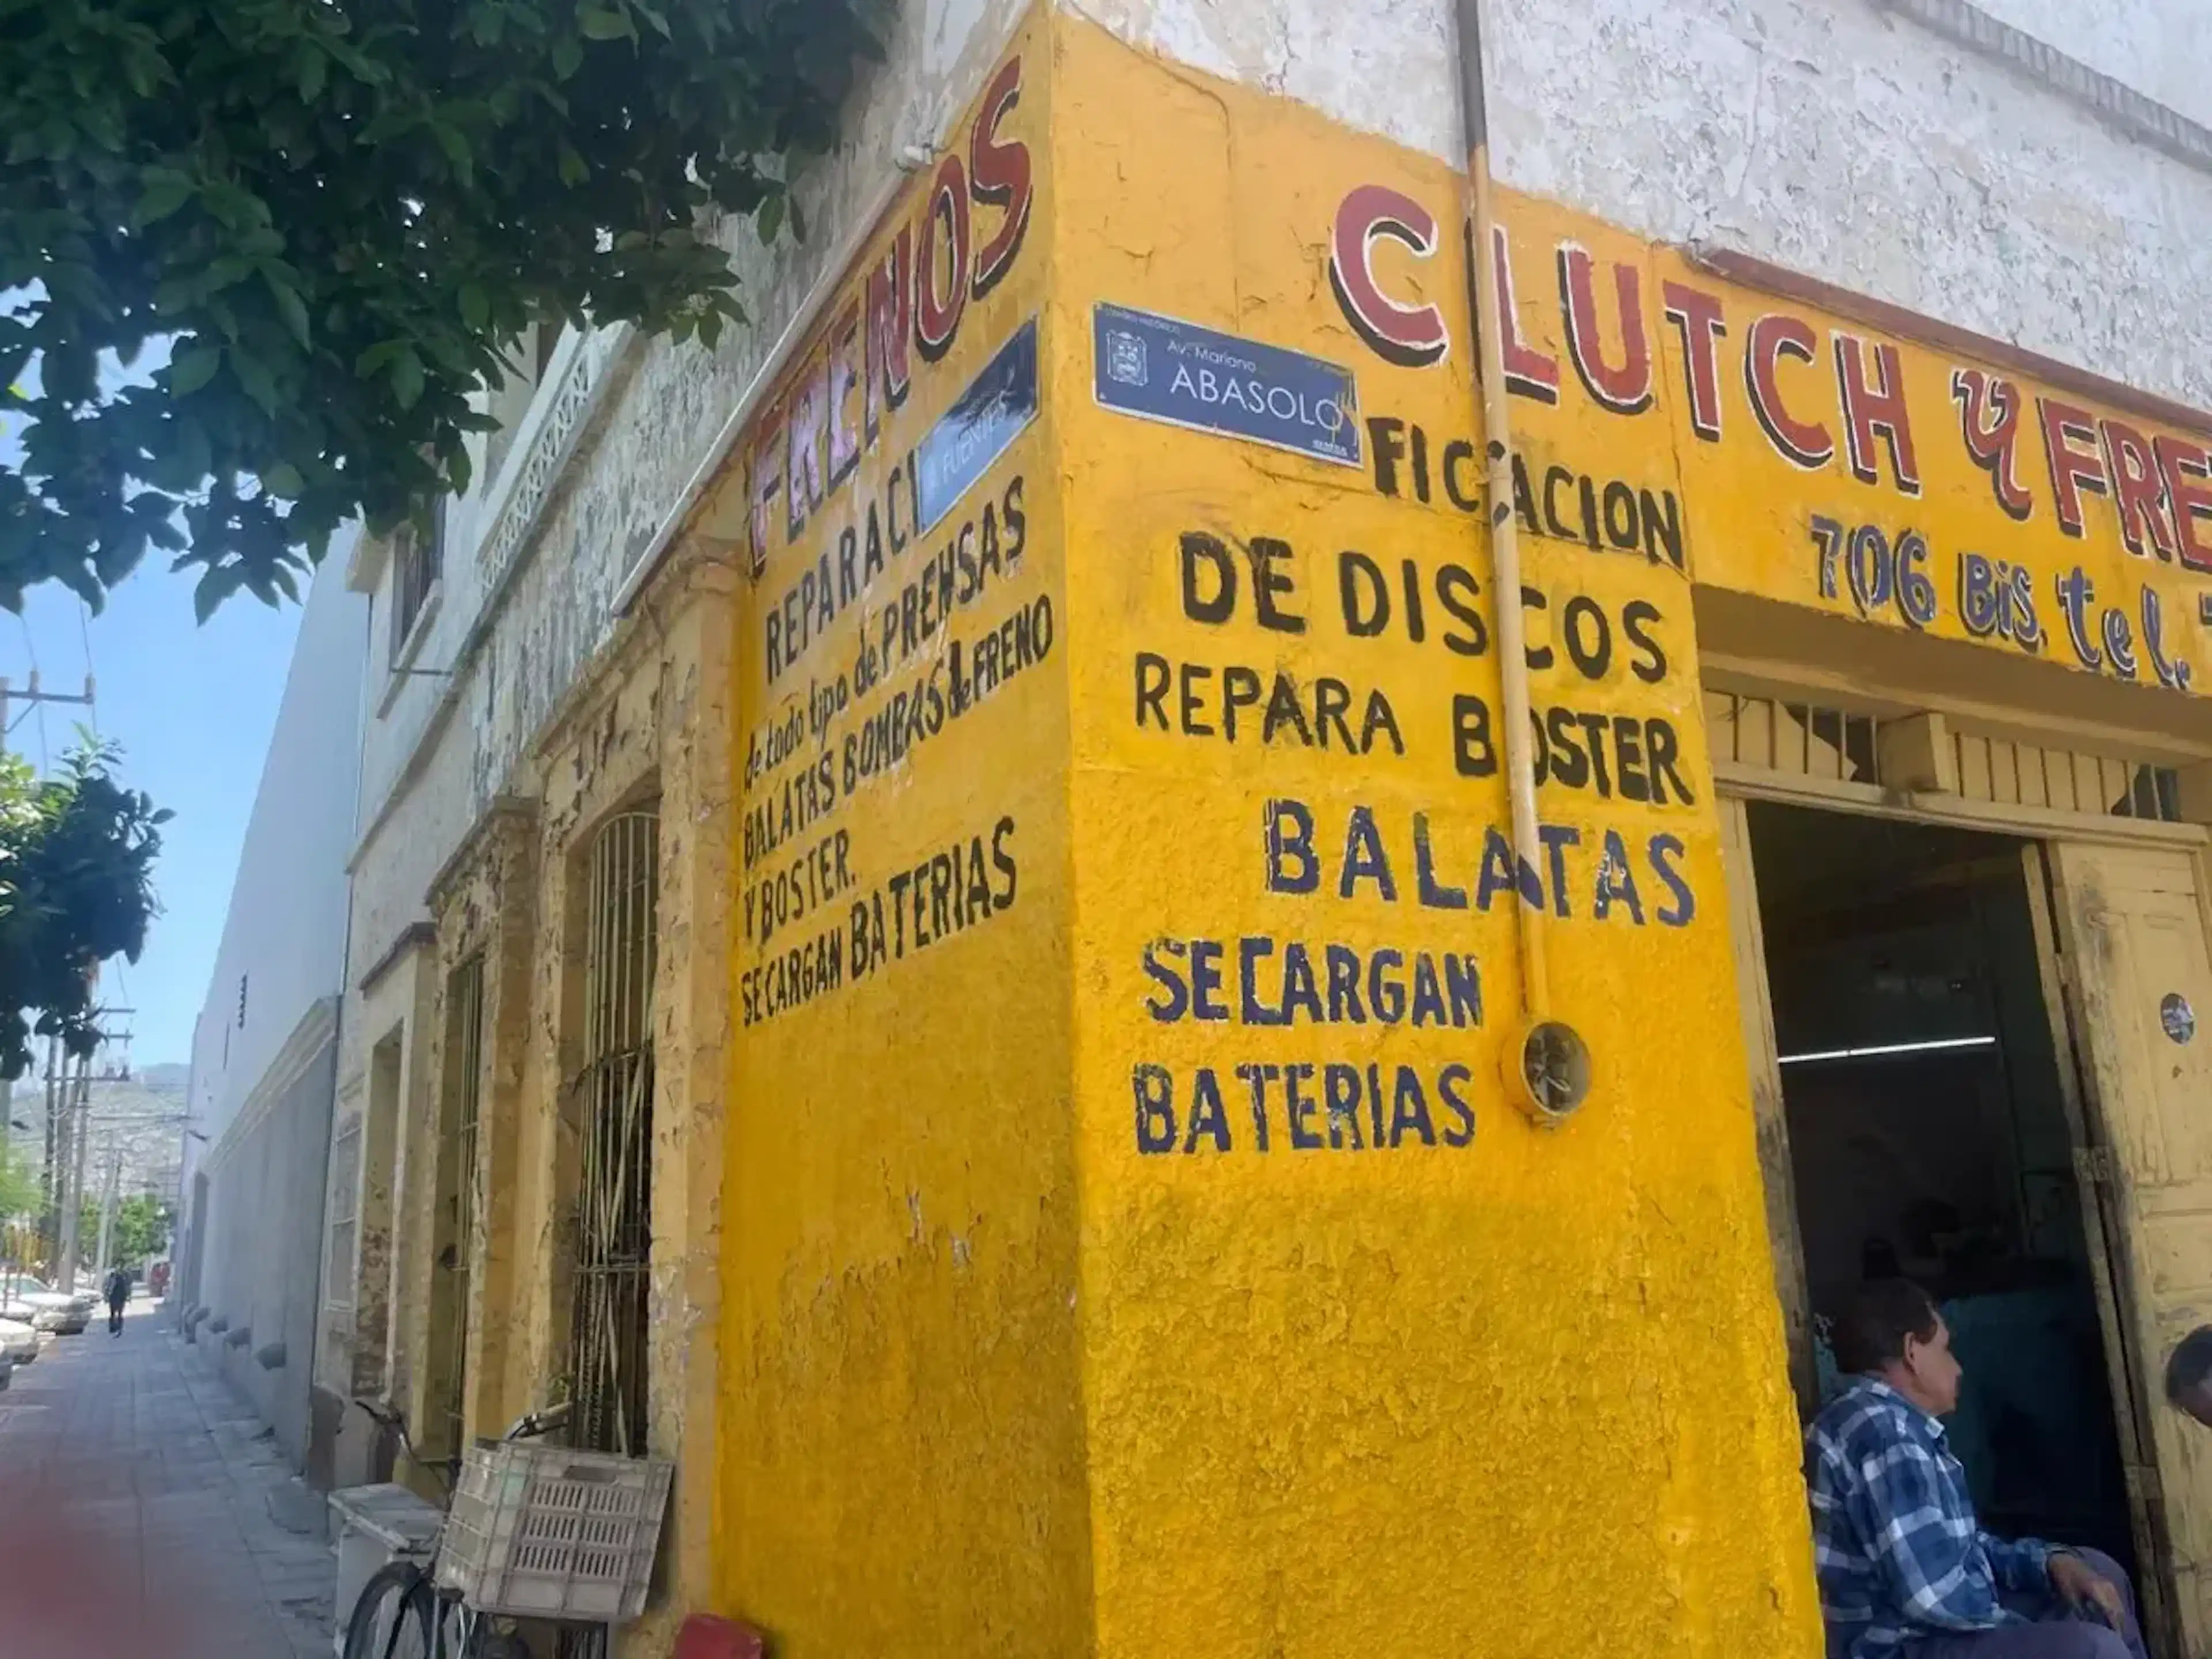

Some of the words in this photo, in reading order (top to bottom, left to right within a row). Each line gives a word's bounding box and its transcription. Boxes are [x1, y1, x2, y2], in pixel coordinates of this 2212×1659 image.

[745, 55, 1033, 576] FRENOS
[1195, 344, 1257, 373] Mariano
[1328, 184, 1922, 498] CLUTCH
[1169, 362, 1343, 432] ABASOLO
[765, 704, 804, 772] todo
[810, 675, 848, 752] tipo
[855, 627, 878, 698] de
[882, 475, 1025, 679] PRENSAS
[767, 449, 919, 685] REPARACI
[1178, 531, 1308, 634] DE
[1338, 550, 1669, 684] DISCOS
[1811, 514, 1937, 632] 706
[744, 751, 835, 872] BALATAS
[843, 657, 944, 797] BOMBAS
[974, 592, 1053, 703] FRENO
[1134, 652, 1406, 756] REPARA
[850, 816, 1017, 982] BATERIAS
[1264, 798, 1696, 927] BALATAS
[1133, 1062, 1475, 1154] BATERIAS
